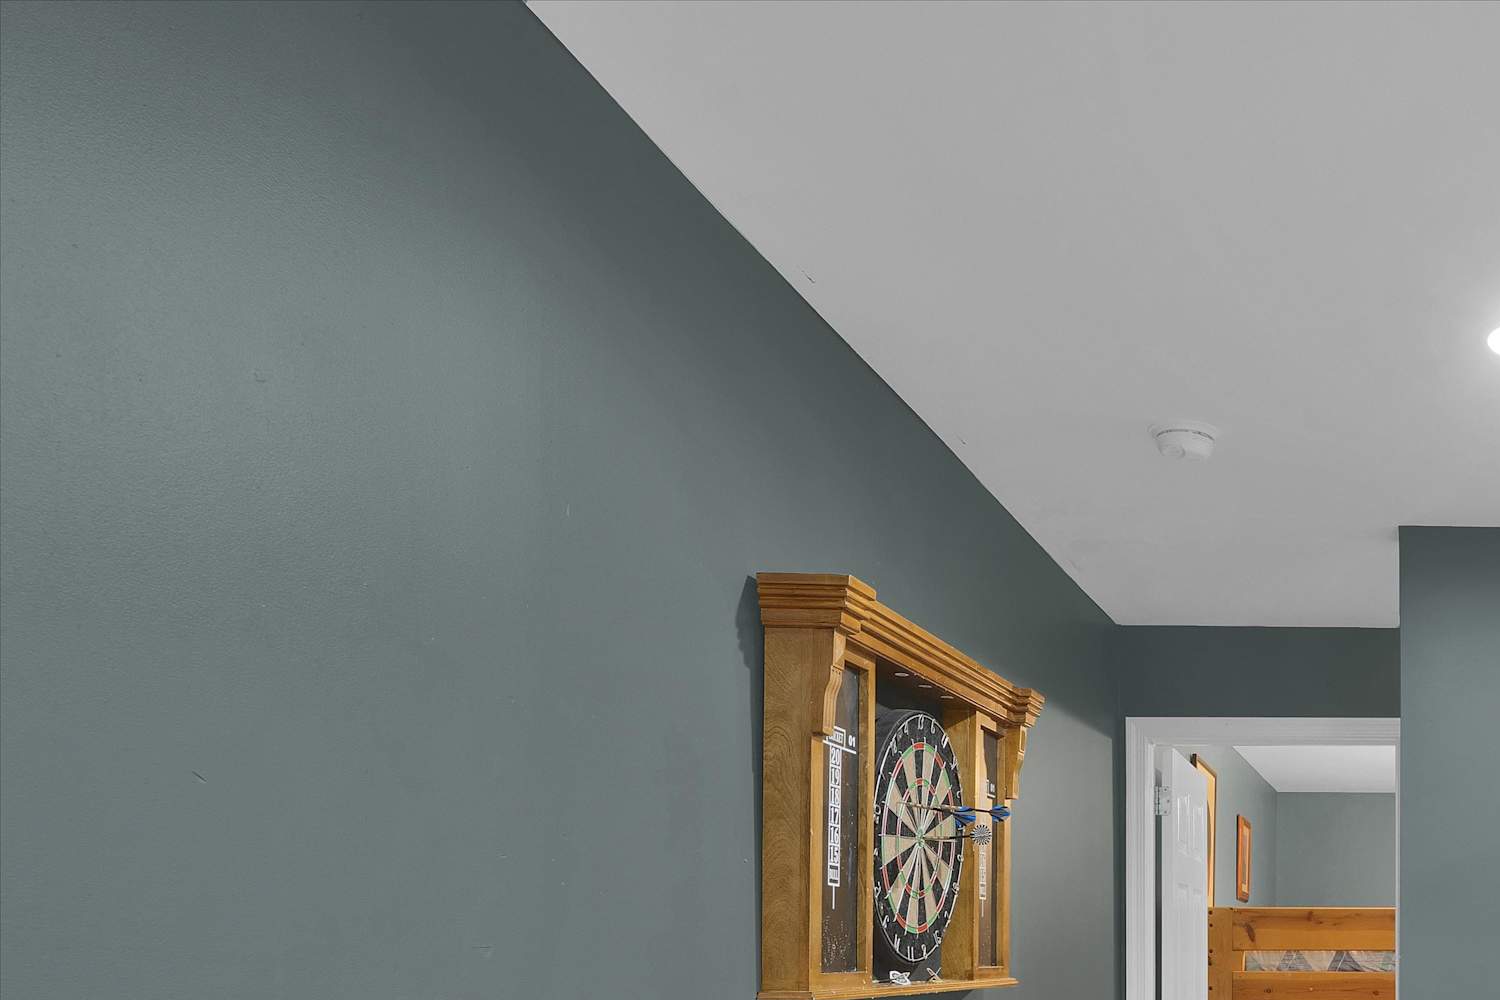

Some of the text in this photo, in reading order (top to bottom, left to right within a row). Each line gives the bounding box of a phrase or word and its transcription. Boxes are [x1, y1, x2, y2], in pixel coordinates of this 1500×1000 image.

[831, 748, 839, 765] 20
[831, 767, 839, 786] 19
[830, 786, 839, 806] 18
[830, 806, 839, 825] 17
[830, 826, 839, 844] 16
[830, 846, 839, 864] 15
